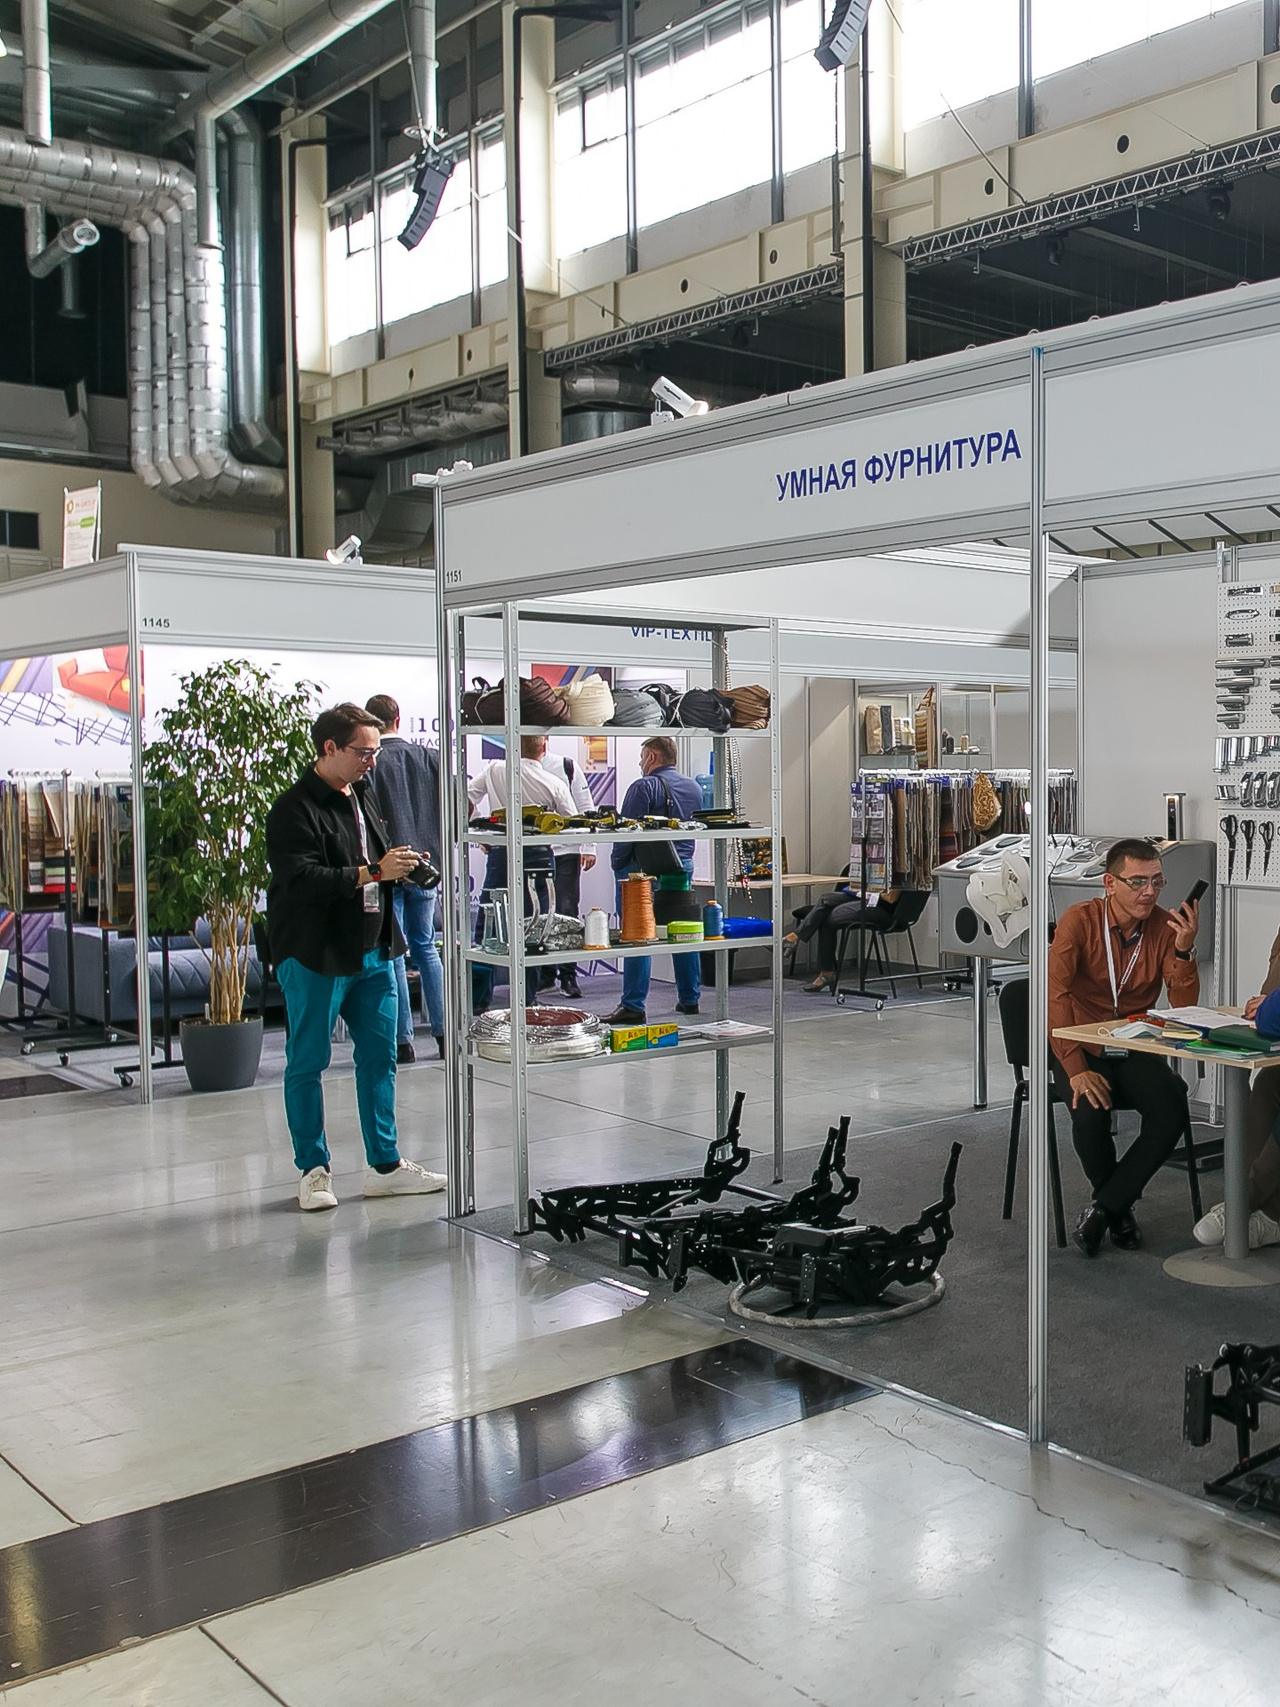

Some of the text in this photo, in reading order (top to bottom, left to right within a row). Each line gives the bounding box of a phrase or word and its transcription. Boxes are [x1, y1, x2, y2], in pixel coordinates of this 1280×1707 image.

[776, 428, 1022, 502] УМНАЯ ФУРНИТУРА
[446, 569, 462, 584] 1151
[142, 616, 170, 629] 1145
